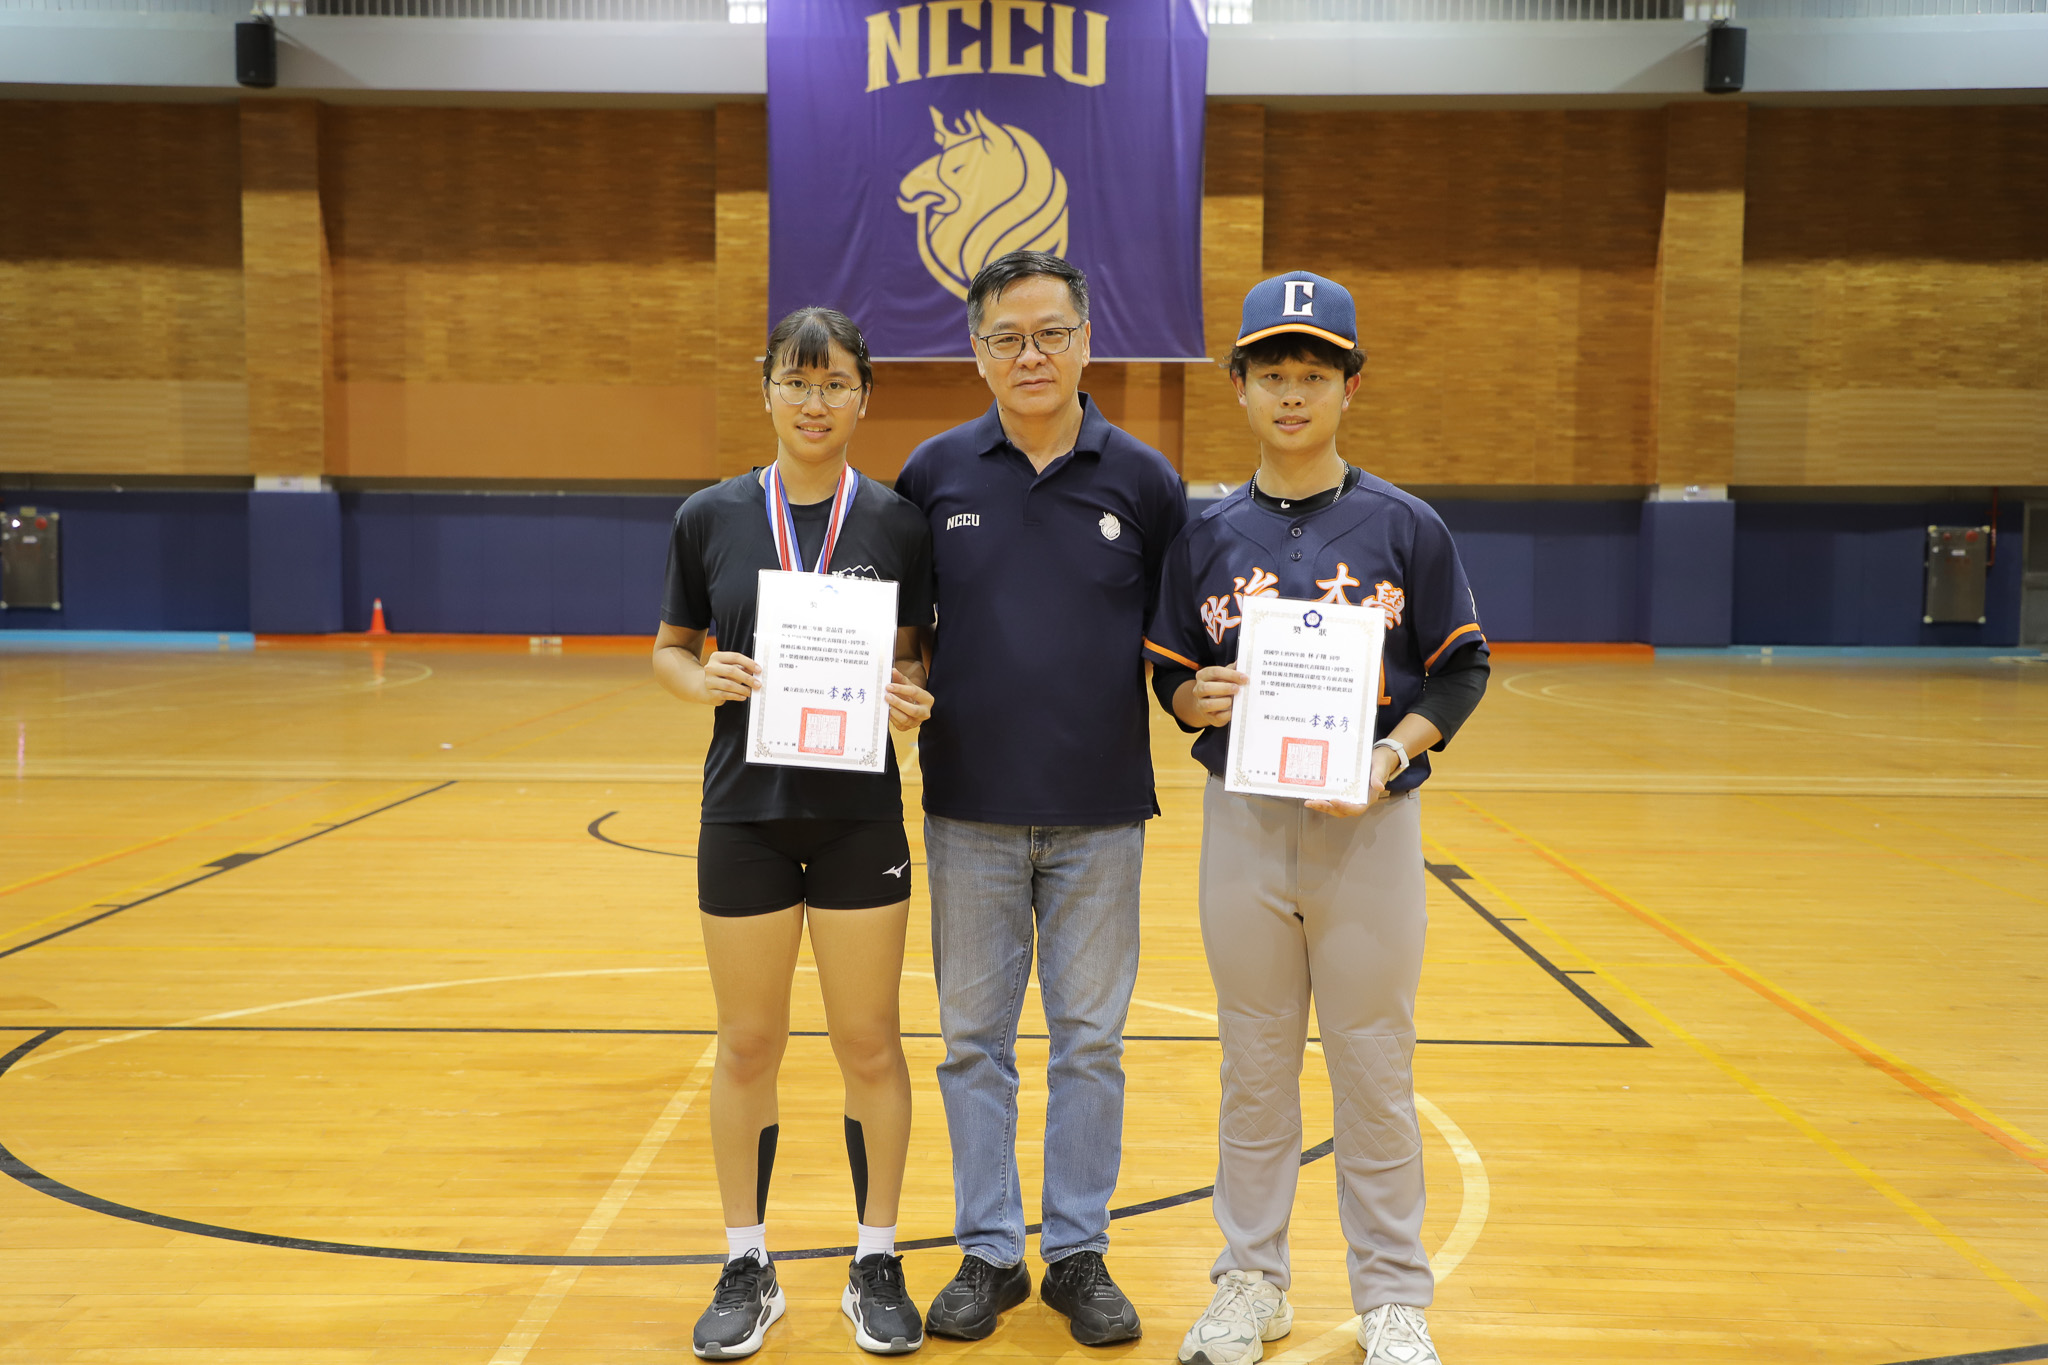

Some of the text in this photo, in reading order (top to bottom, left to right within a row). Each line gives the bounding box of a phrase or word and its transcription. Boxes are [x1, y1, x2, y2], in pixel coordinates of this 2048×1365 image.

[865, 0, 1109, 93] NCCU
[1282, 280, 1315, 317] C
[946, 513, 980, 531] NCCU
